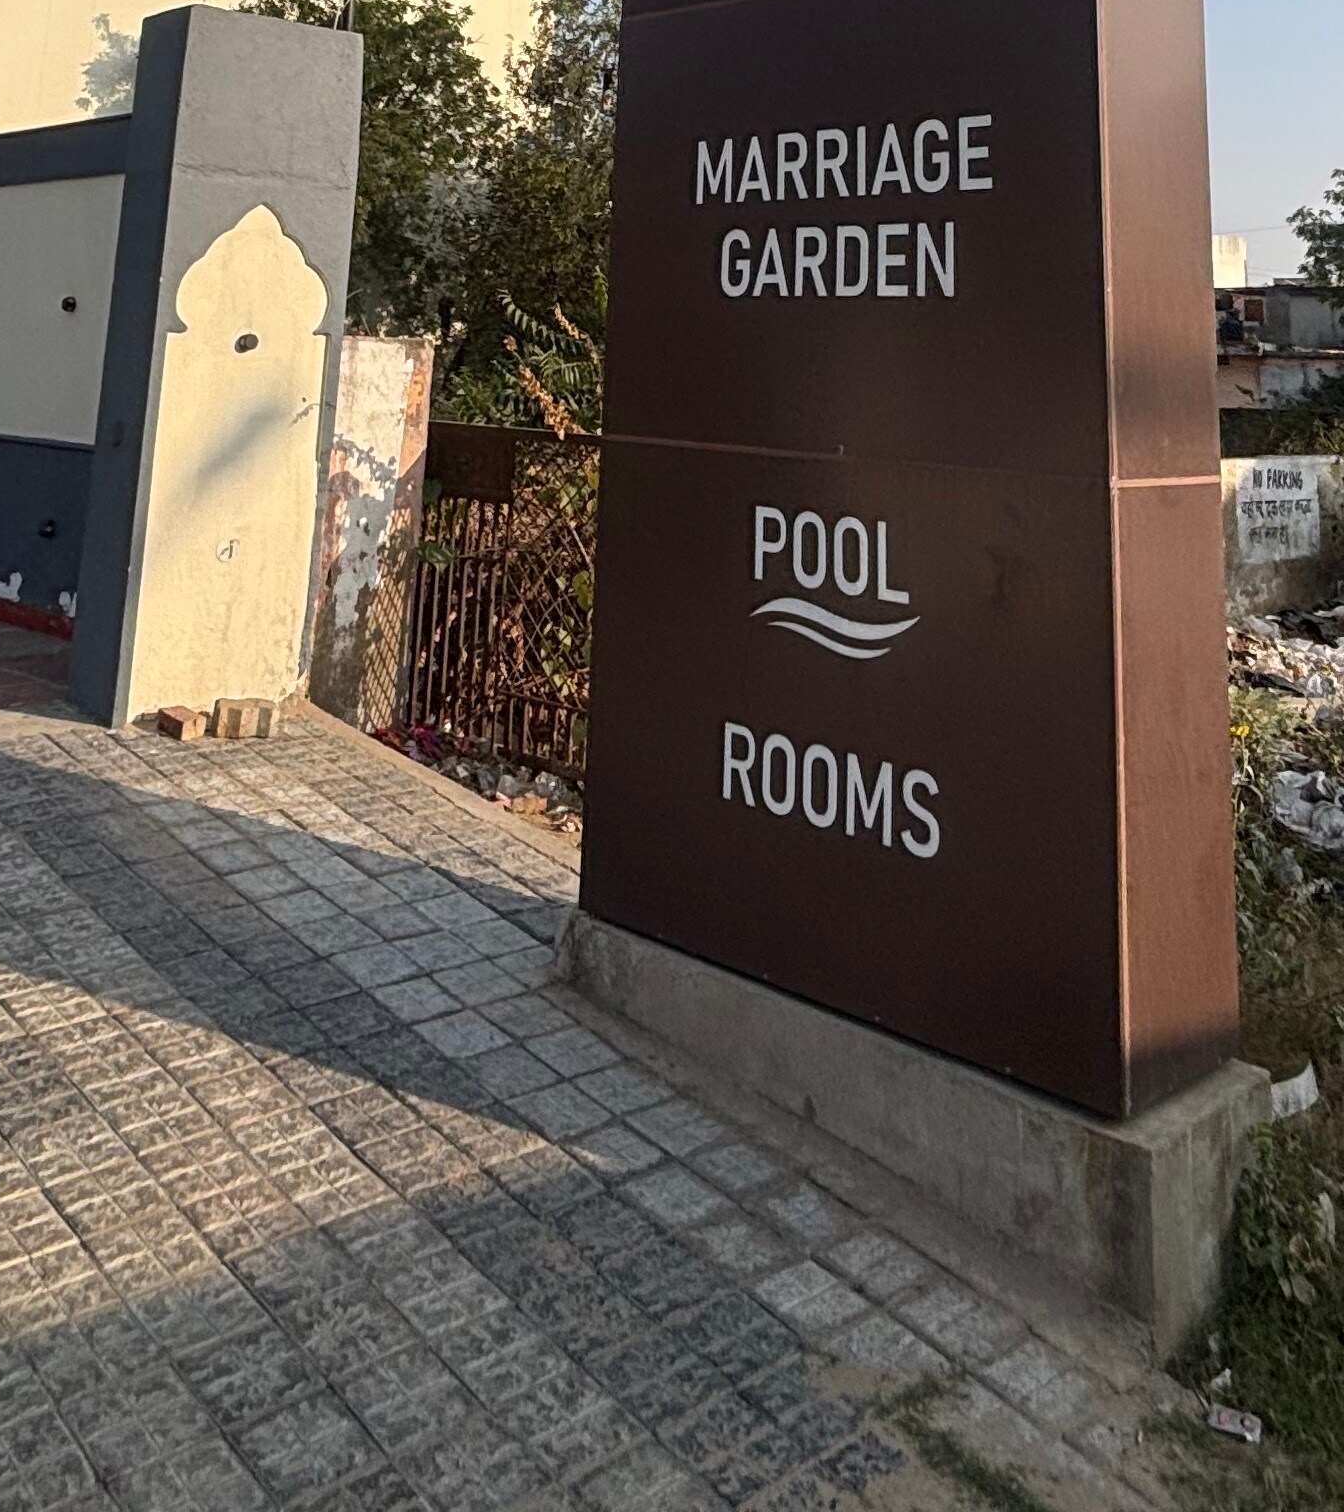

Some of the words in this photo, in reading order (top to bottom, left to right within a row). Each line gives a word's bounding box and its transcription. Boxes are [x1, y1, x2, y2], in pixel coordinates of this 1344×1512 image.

[695, 113, 993, 205] MARRIAGE
[720, 221, 955, 298] GARDEN
[1267, 468, 1304, 491] PARKING
[754, 504, 910, 605] POOL
[722, 720, 941, 859] ROOMS
